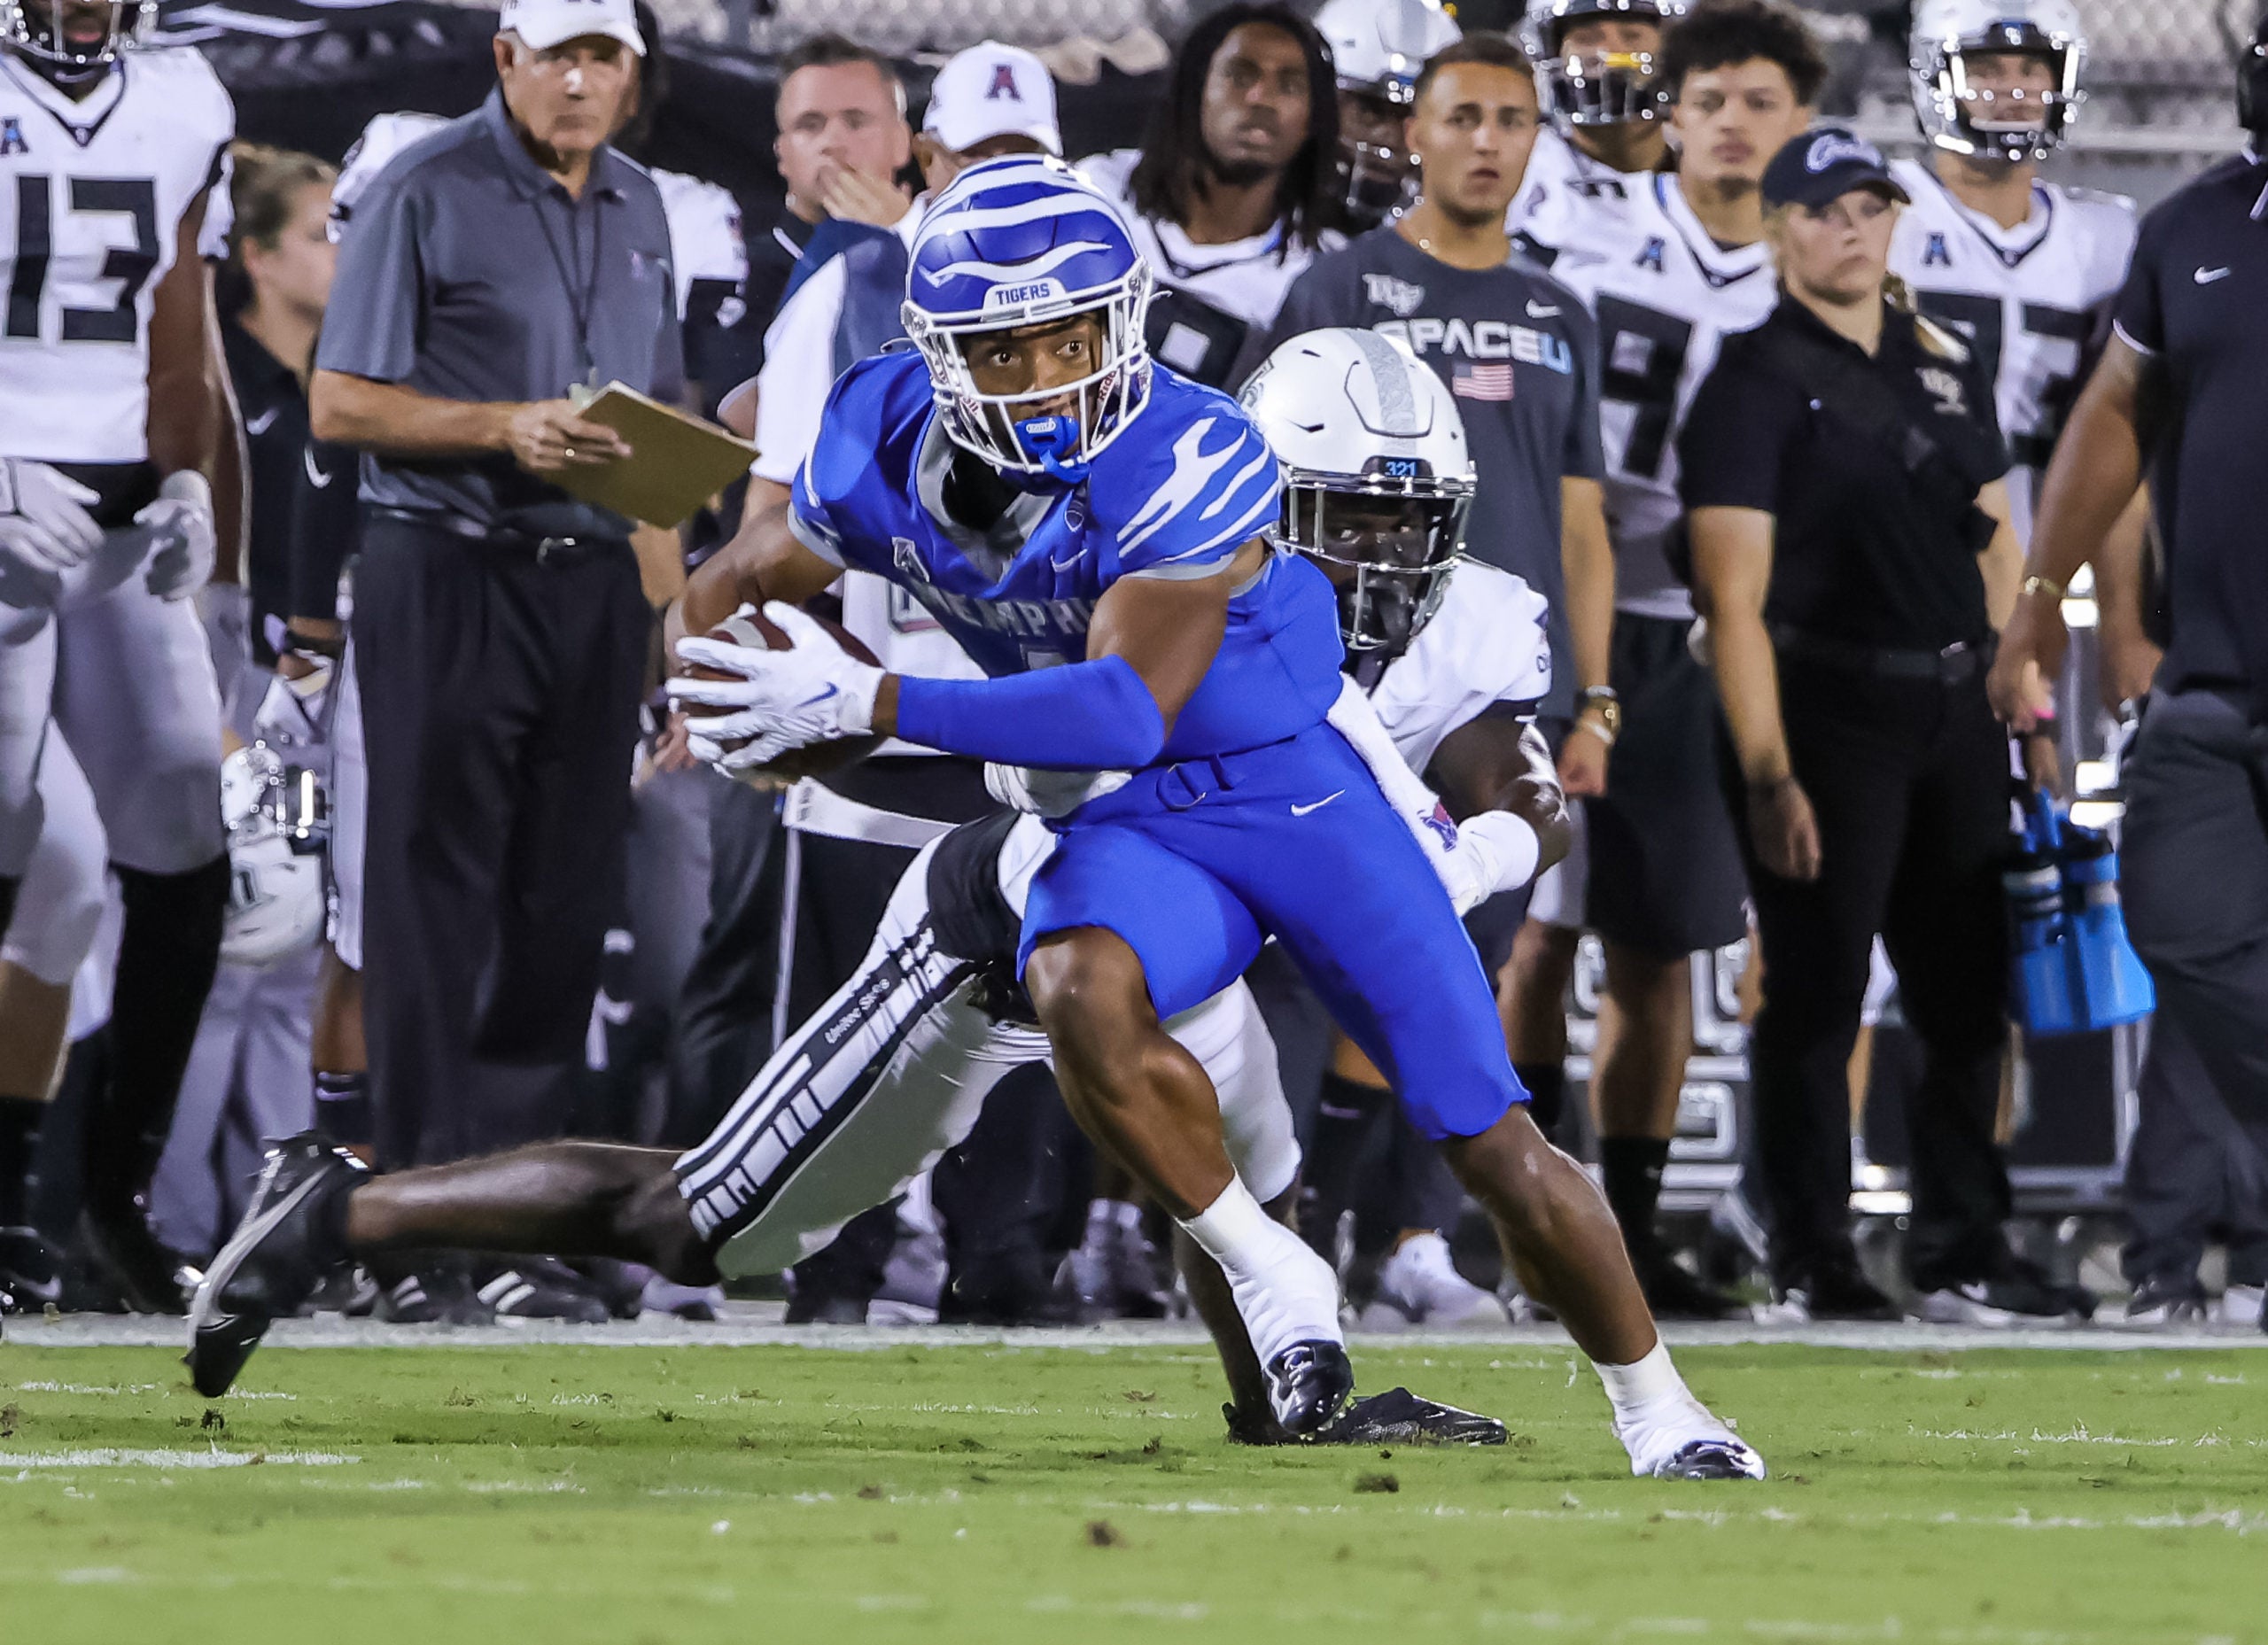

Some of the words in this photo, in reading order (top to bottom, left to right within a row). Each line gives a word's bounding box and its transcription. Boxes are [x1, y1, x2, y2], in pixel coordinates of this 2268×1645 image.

[984, 66, 1023, 101] A
[7, 175, 161, 342] 13
[996, 283, 1050, 306] TIGERS
[1385, 461, 1416, 477] 321
